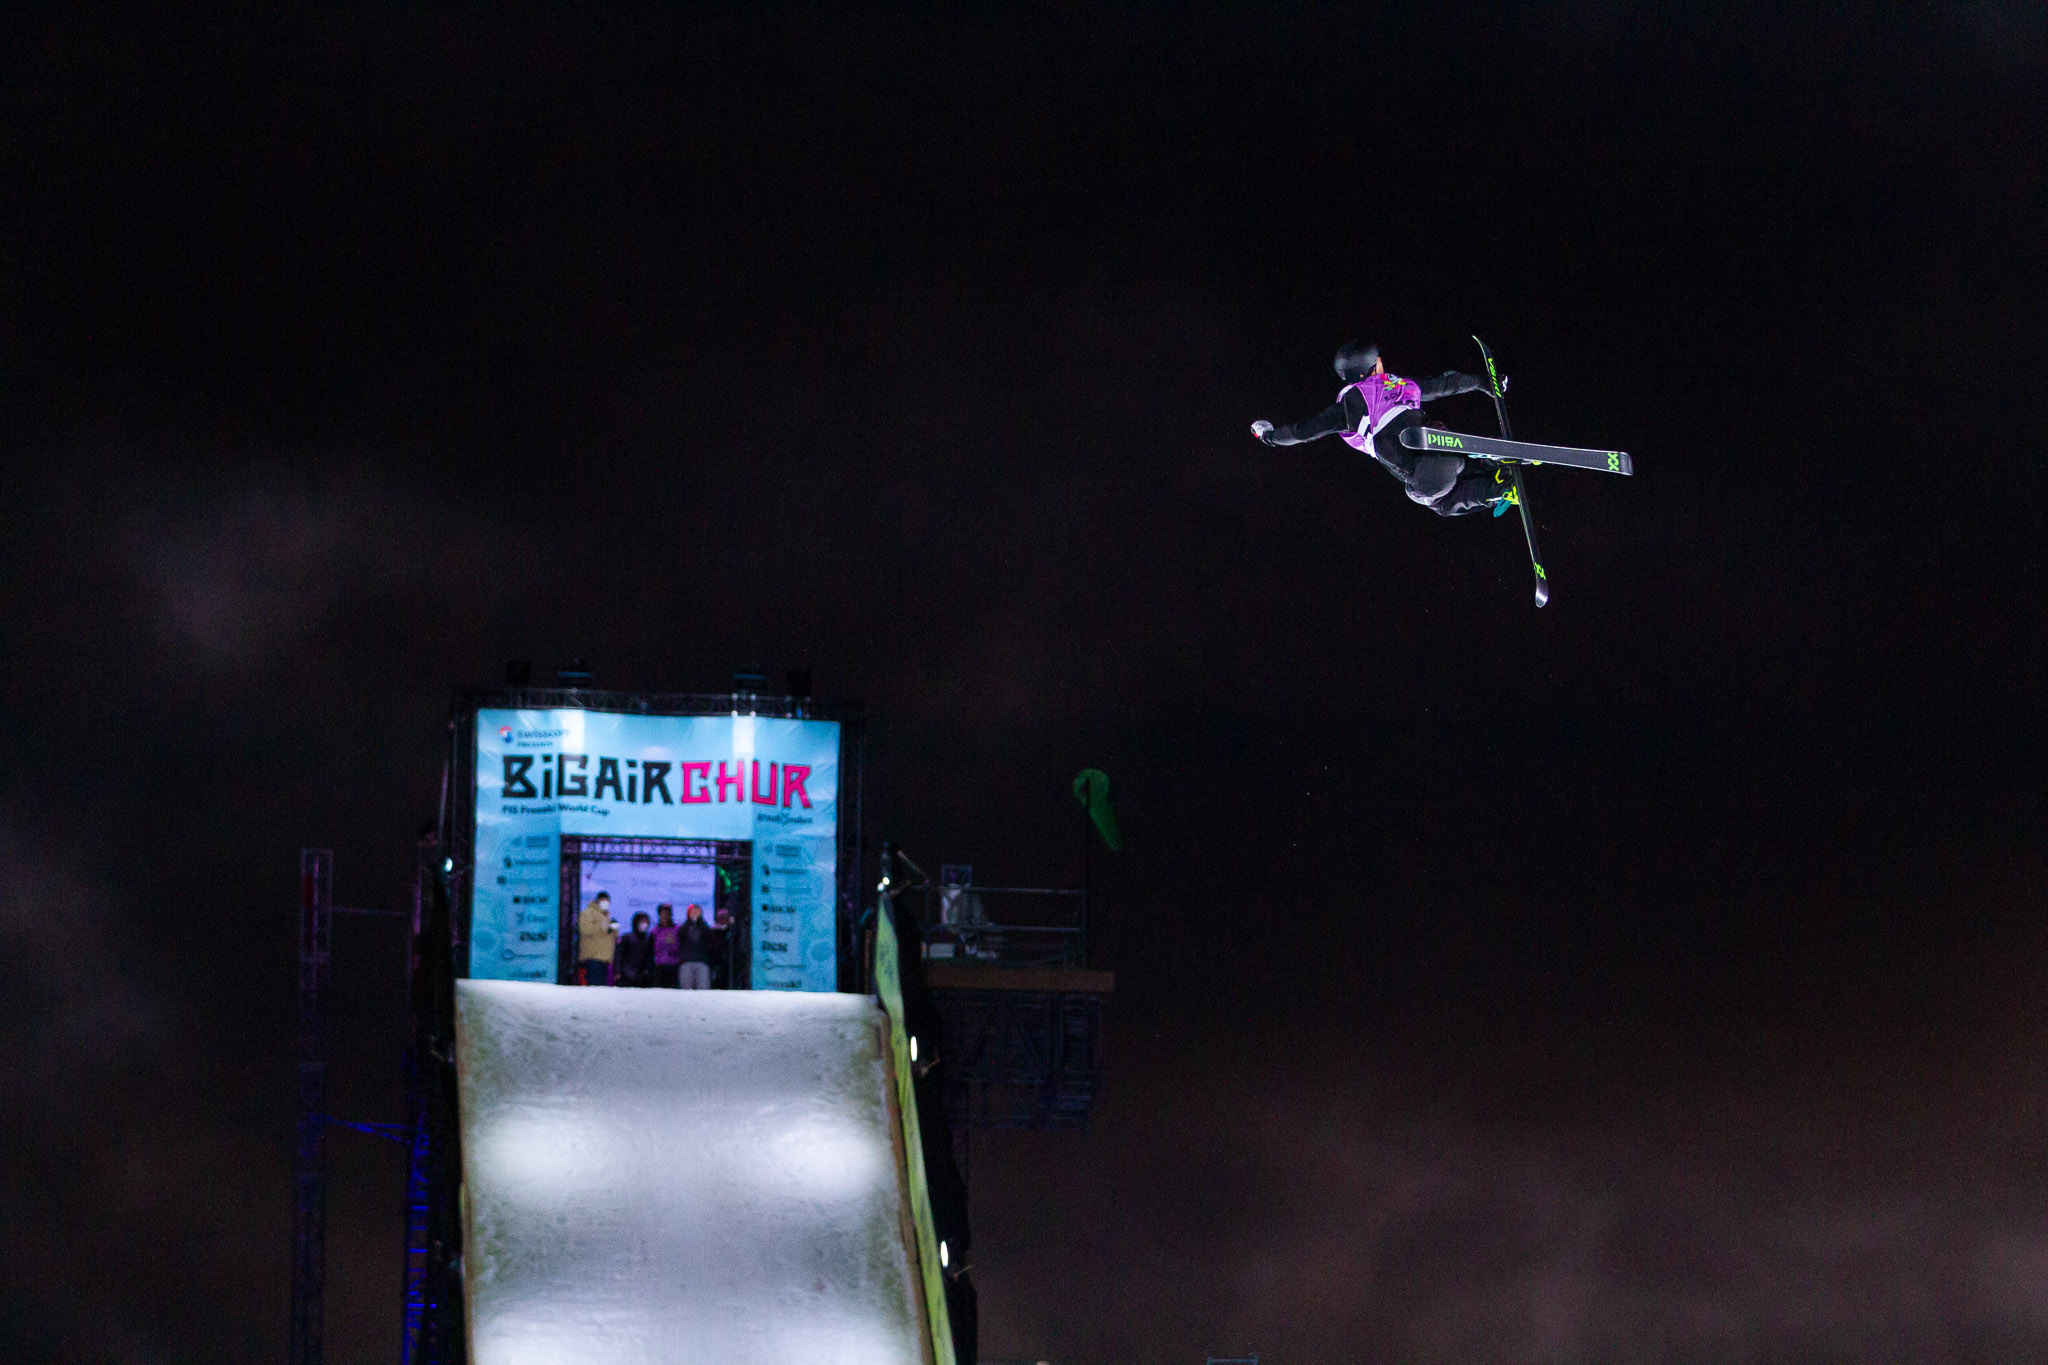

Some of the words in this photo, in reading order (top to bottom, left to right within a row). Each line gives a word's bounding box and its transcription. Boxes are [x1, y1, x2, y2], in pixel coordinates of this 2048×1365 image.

[681, 759, 813, 808] CHUR
[558, 802, 588, 813] World
[590, 804, 610, 816] Cup
